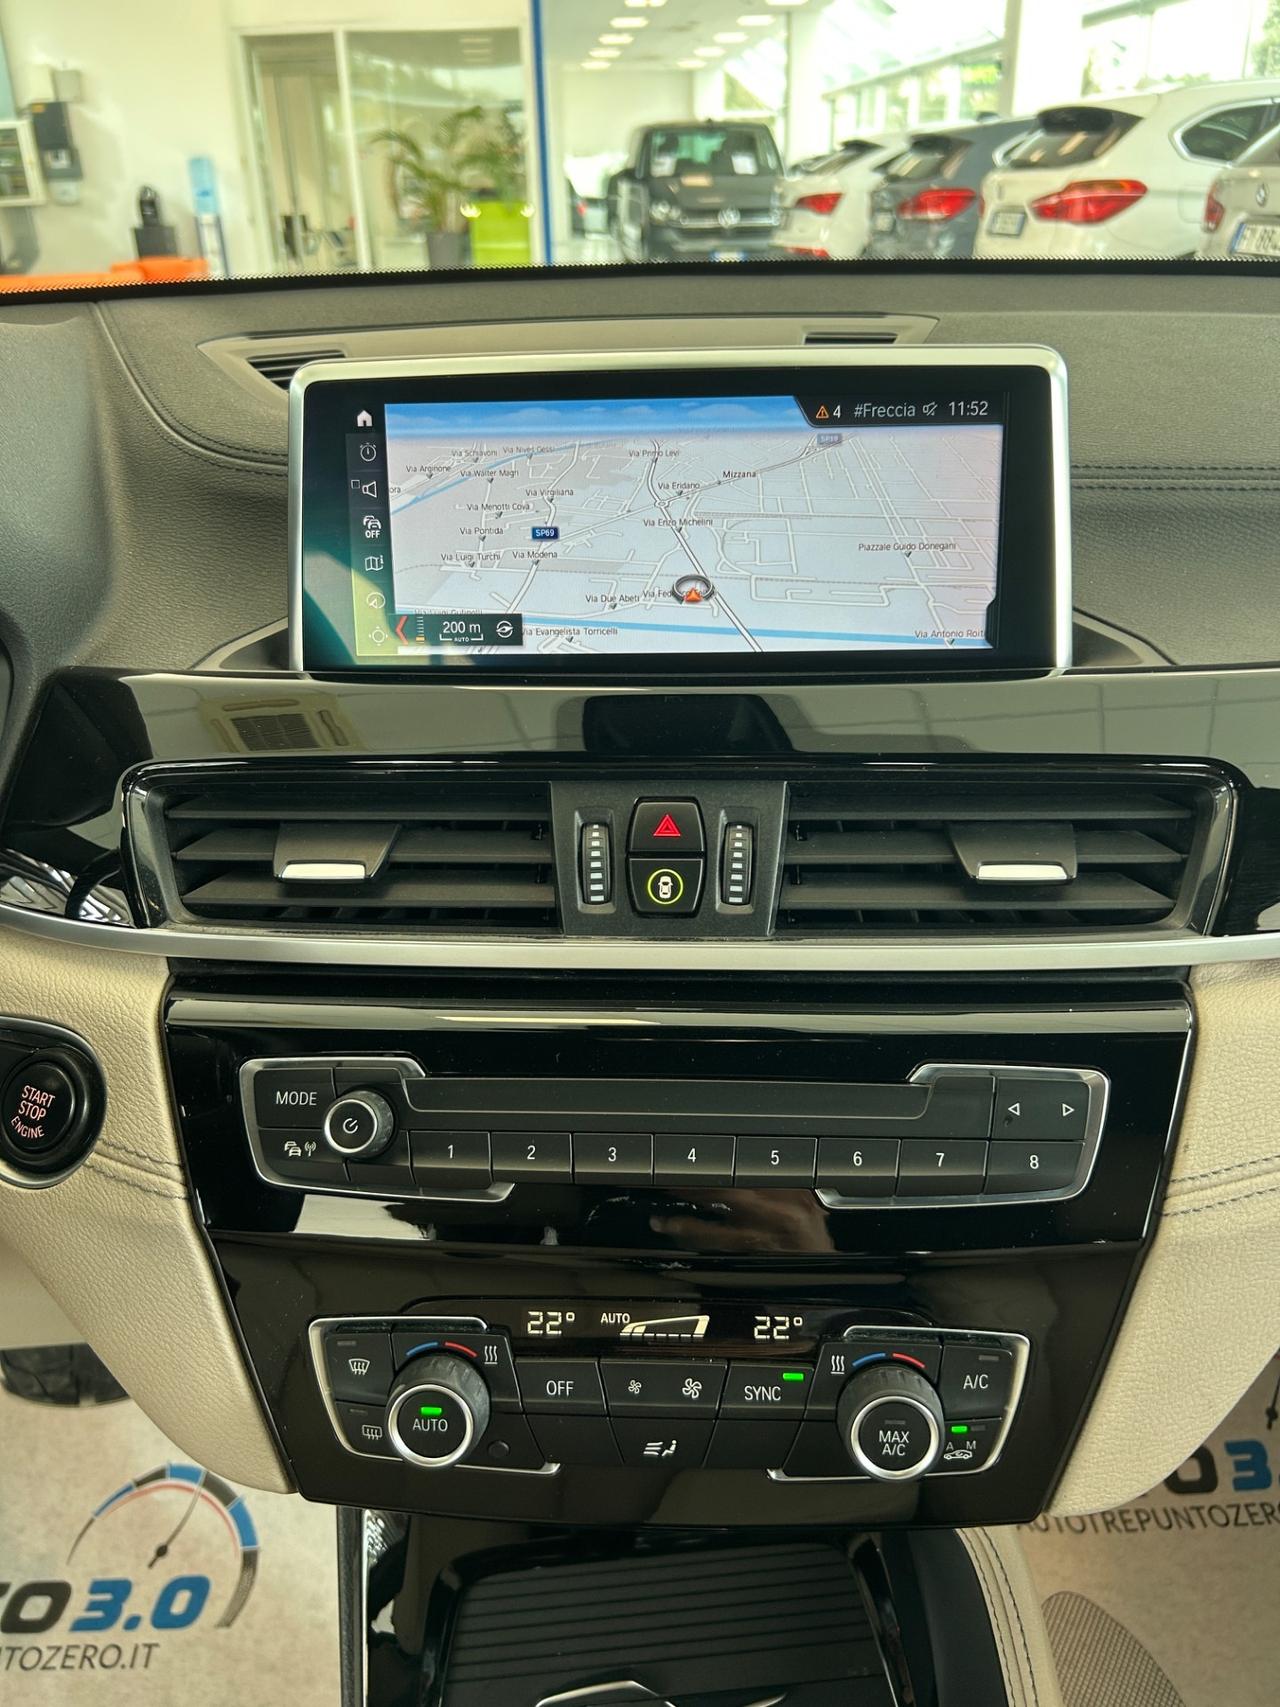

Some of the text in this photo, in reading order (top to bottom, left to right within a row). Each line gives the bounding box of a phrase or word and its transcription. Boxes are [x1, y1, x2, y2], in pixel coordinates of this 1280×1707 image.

[833, 405, 842, 419] 4
[853, 402, 916, 419] #Freccia
[949, 400, 989, 417] 11:52
[642, 449, 664, 457] Primo
[665, 448, 680, 456] Levi
[405, 464, 451, 474] Via Arginone
[472, 469, 496, 477] Walter
[722, 470, 757, 479] Mizzana
[525, 488, 574, 498] Via Virgiliana
[658, 482, 700, 490] Via Eridano
[466, 503, 530, 511] Via Menotti Cova
[643, 517, 714, 527] Via Enzo Michelini
[365, 531, 380, 539] OFF
[459, 526, 504, 535] Via Pontida
[535, 529, 555, 538] SP69
[858, 541, 957, 552] Piazzale Guido Donegani
[440, 552, 501, 563] Via Luigi Turchi
[512, 550, 558, 559] Via Modena
[585, 594, 640, 603] Via Due Abeti
[642, 589, 655, 598] Via
[442, 621, 481, 634] 200 m
[535, 627, 581, 638] Evangelista
[583, 627, 618, 636] Torricelli
[914, 629, 928, 638] Via
[930, 629, 964, 638] Antonio
[21, 1085, 56, 1108] START
[275, 1090, 318, 1107] MODE
[18, 1100, 47, 1121] STOP
[10, 1115, 46, 1139] ENGINE
[446, 1145, 455, 1159] 1
[526, 1144, 536, 1161] 2
[607, 1146, 618, 1162] 3
[686, 1148, 698, 1163] 4
[769, 1150, 780, 1166] 5
[852, 1151, 863, 1167] 6
[935, 1152, 945, 1169] 7
[1028, 1154, 1040, 1170] 8
[600, 1311, 631, 1325] AUTO
[545, 1380, 575, 1397] OFF
[963, 1374, 989, 1390] A/C
[743, 1385, 782, 1402] SYNC
[412, 1417, 449, 1433] AUTO
[878, 1430, 910, 1444] MAX
[881, 1443, 907, 1457] A/C
[965, 1440, 978, 1450] M
[0, 1575, 211, 1634] O 3.0
[0, 1642, 161, 1672] TOZERO.IT
